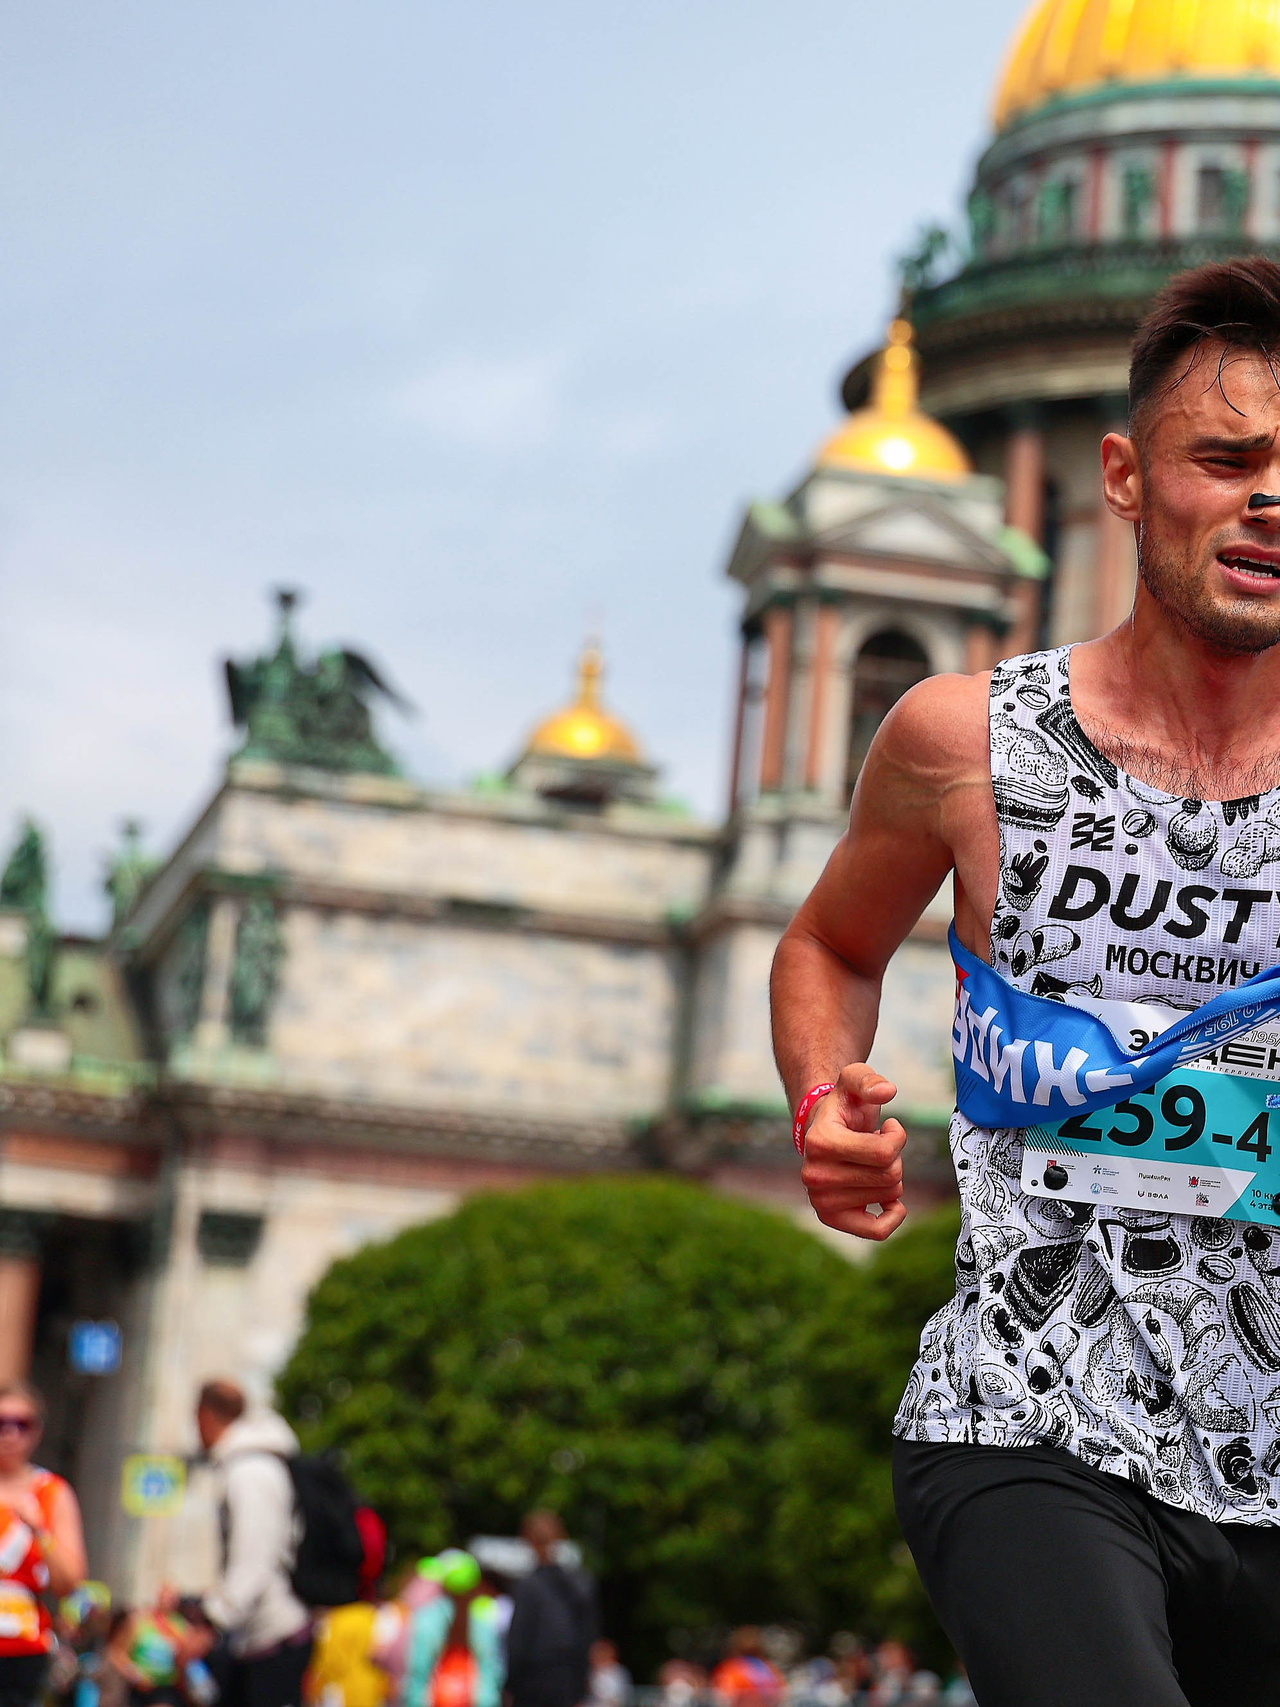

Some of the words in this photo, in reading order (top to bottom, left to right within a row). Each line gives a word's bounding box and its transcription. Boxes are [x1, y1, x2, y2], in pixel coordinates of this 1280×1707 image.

[1105, 944, 1261, 986] МОСКВИЧ
[1252, 1189, 1262, 1198] 10
[1250, 1200, 1256, 1208] 4
[1258, 1203, 1275, 1211] эта
